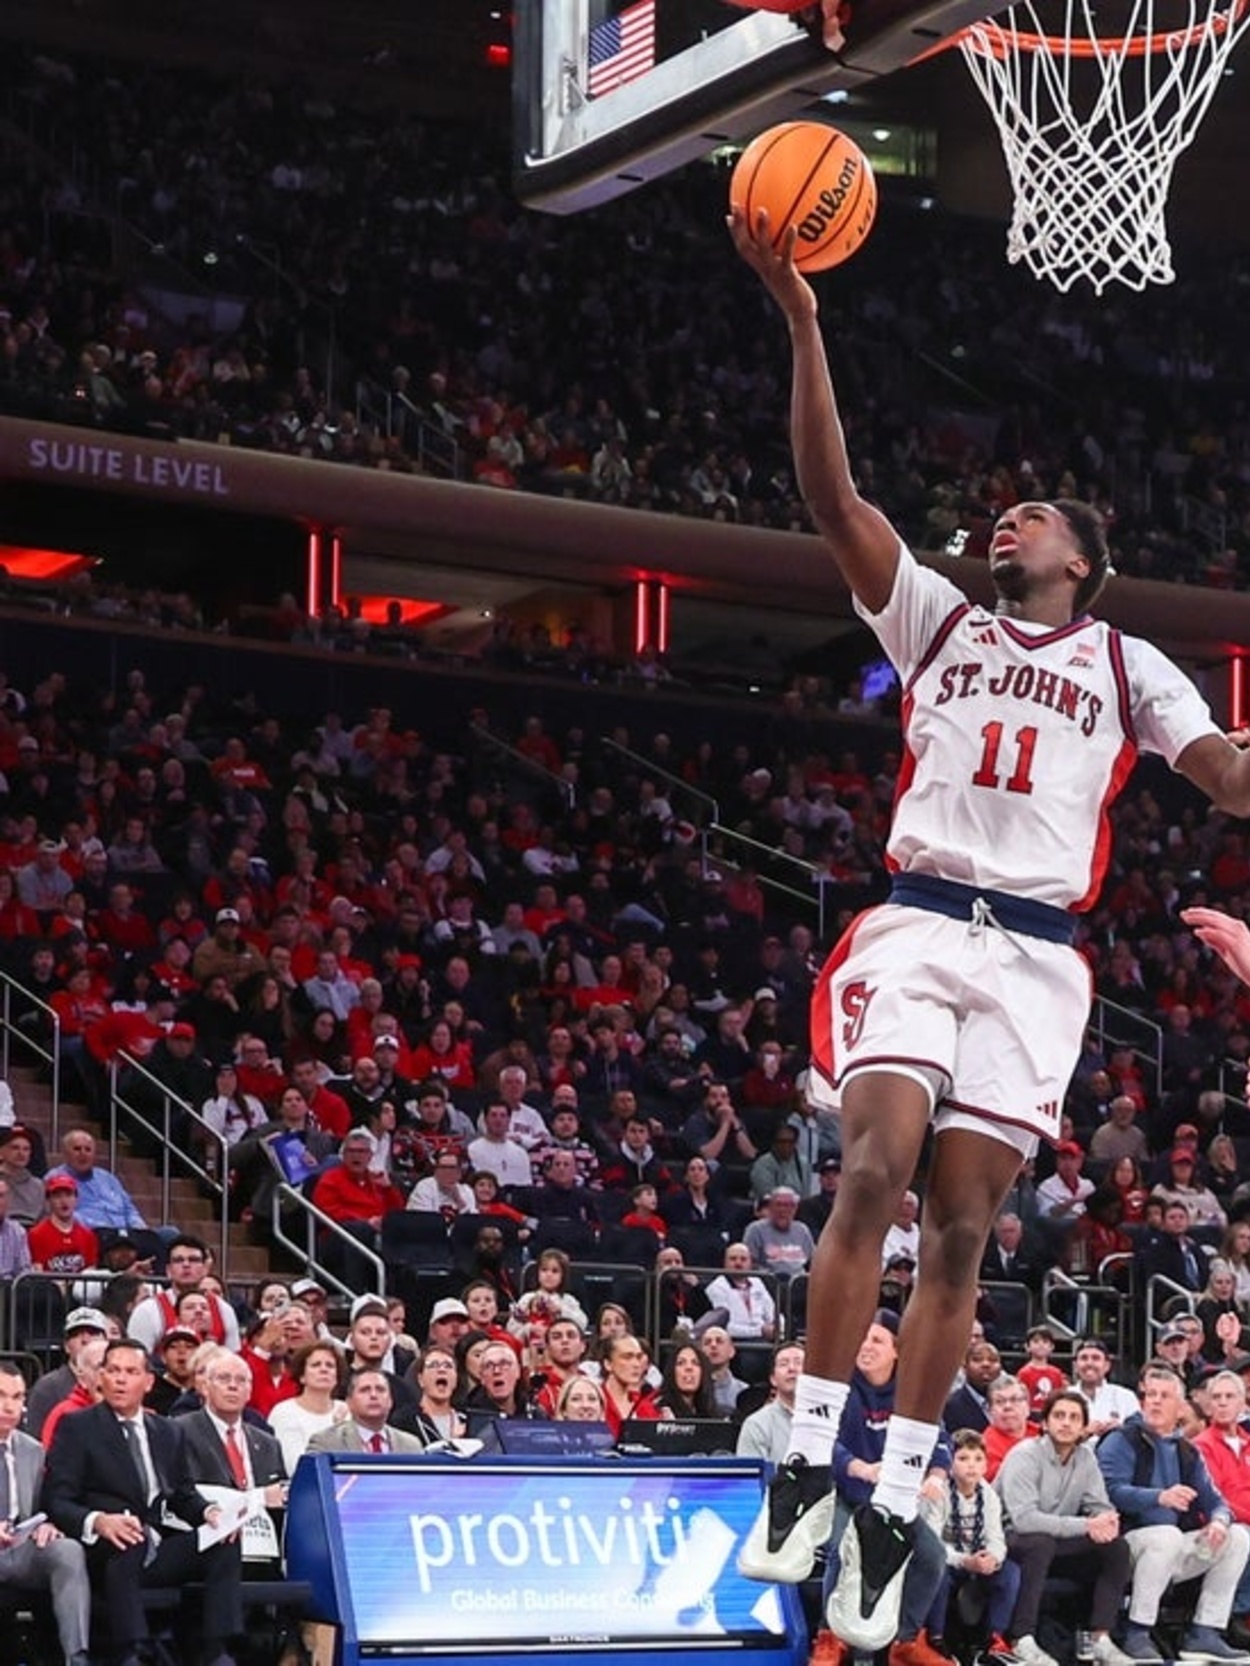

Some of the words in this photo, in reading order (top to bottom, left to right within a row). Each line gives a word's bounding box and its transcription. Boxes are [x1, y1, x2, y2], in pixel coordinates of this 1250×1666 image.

[797, 157, 858, 243] Wilson
[29, 438, 124, 480] SUITE
[135, 454, 230, 494] LEVEL
[934, 663, 983, 706] ST.
[988, 664, 1103, 737] JOHN'S
[971, 720, 1039, 795] 11
[409, 1497, 689, 1593] protiviti
[451, 1588, 518, 1612] Global
